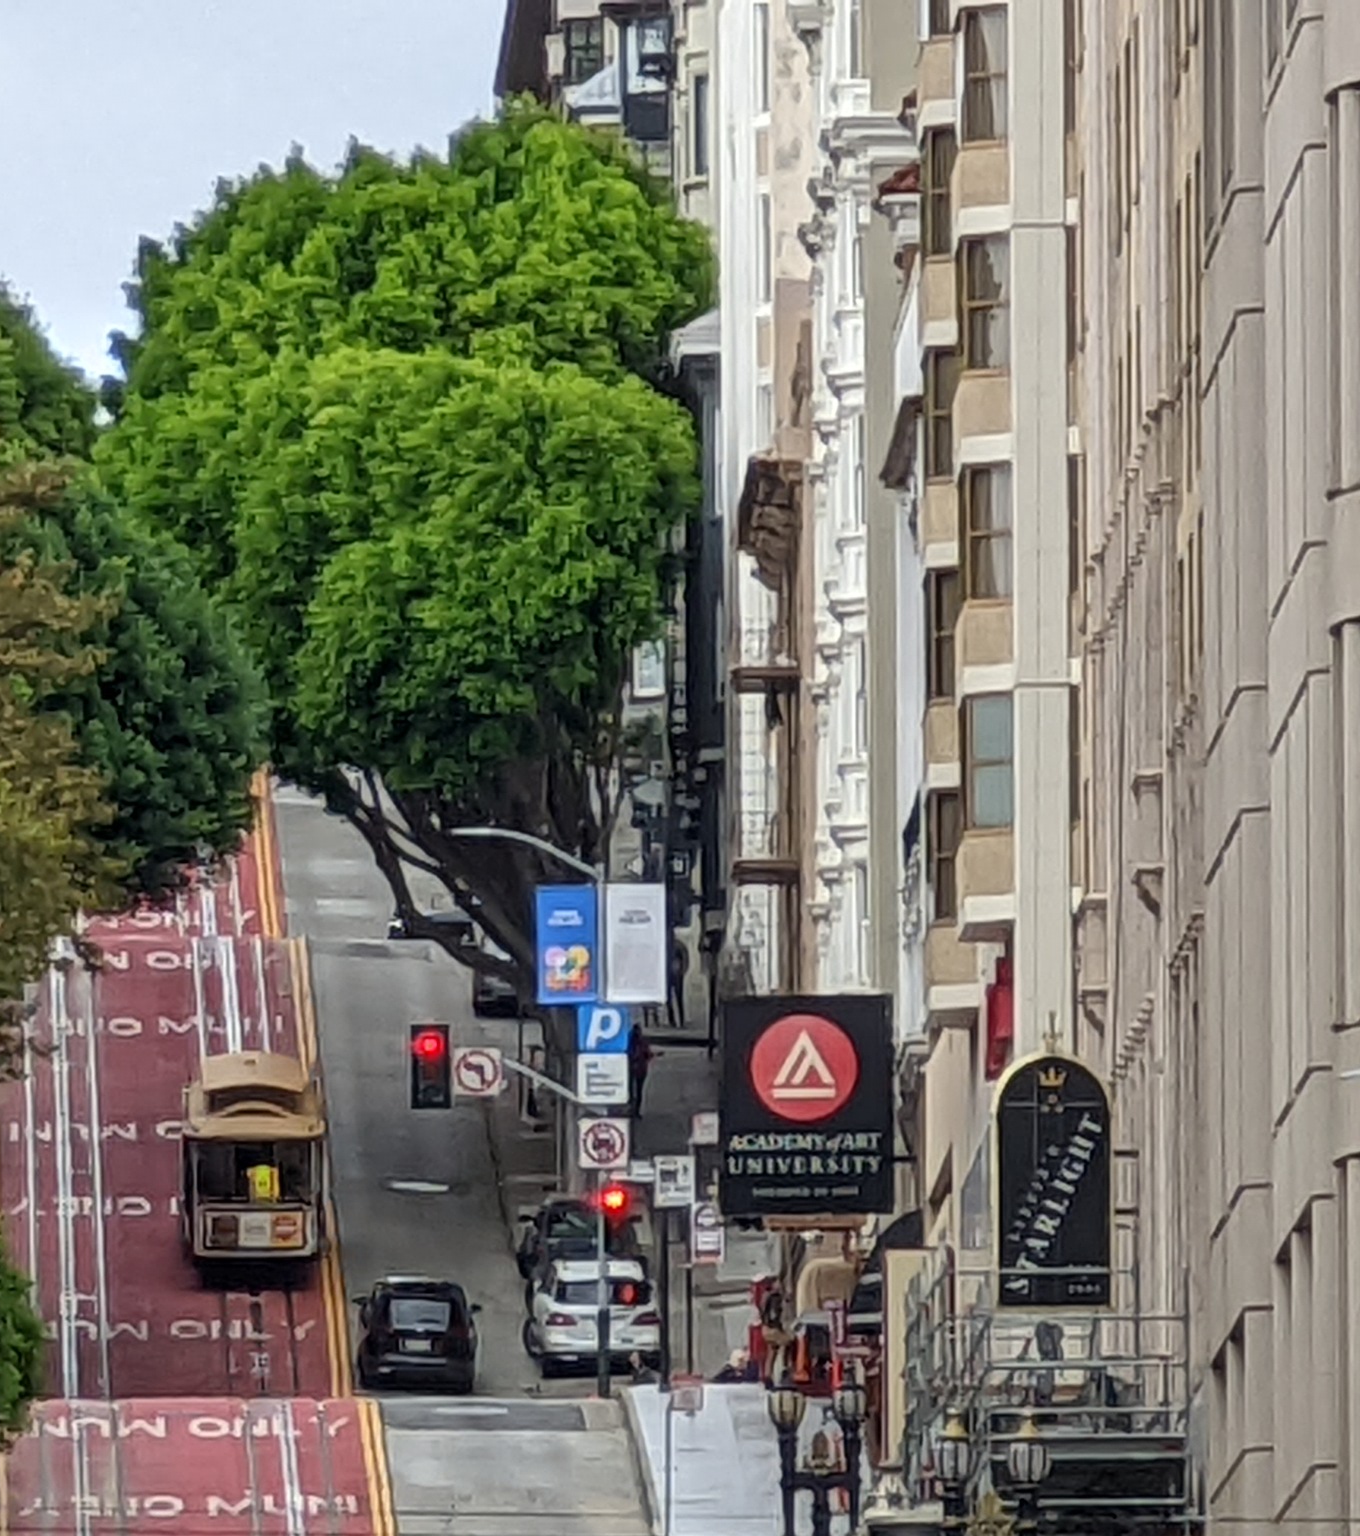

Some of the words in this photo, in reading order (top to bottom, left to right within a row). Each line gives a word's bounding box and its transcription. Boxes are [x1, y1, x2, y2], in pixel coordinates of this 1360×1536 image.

[729, 1133, 827, 1151] ACADEMY
[727, 1154, 882, 1175] UNIVERSITY
[190, 1415, 349, 1438] ONLY
